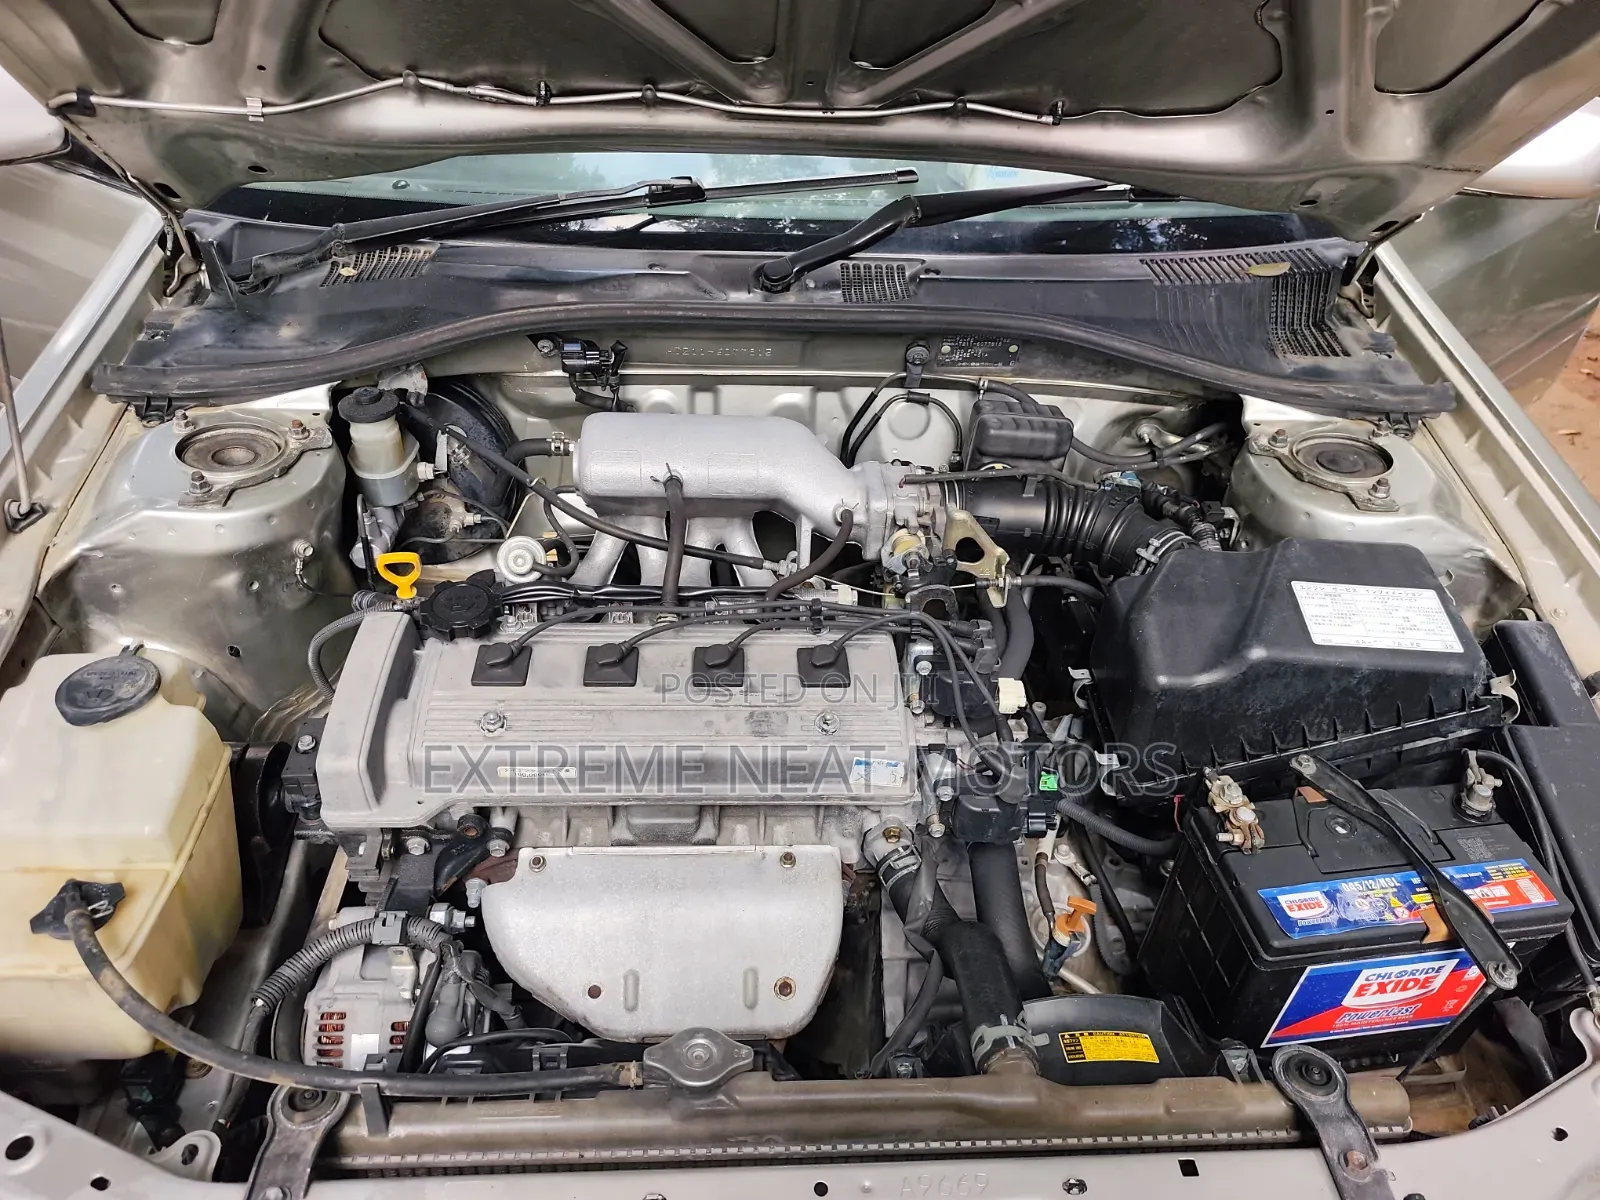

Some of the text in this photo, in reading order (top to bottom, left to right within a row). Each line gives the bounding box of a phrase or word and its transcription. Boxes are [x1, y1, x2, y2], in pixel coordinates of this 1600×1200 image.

[1284, 896, 1320, 905] CHLORIDE
[1286, 900, 1324, 912] EXIDE
[1364, 965, 1447, 982] CHLORIDE
[1352, 975, 1440, 998] EXIDE
[900, 1172, 990, 1198] A9669
